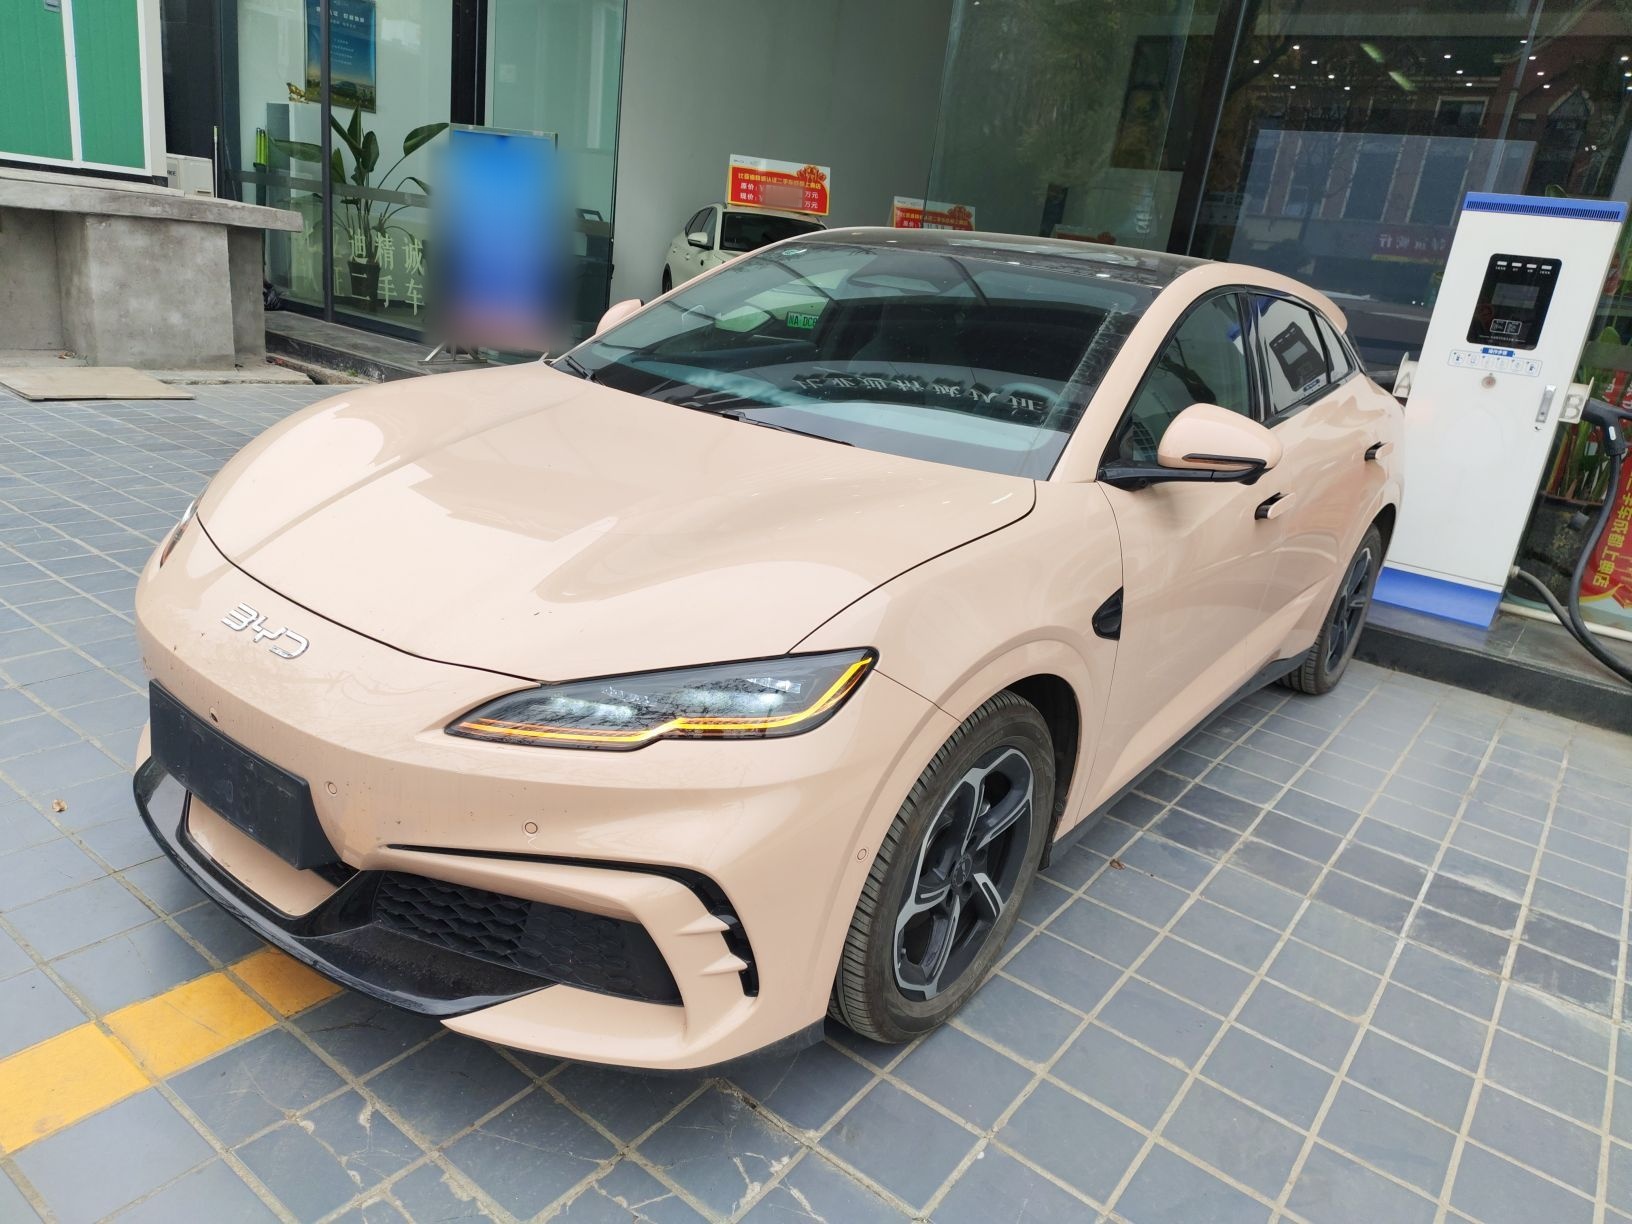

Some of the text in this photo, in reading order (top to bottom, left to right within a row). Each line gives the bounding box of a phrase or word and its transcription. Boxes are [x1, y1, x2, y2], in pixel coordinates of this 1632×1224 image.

[1394, 371, 1411, 397] A
[1560, 394, 1582, 419] B
[221, 602, 310, 659] BYD
